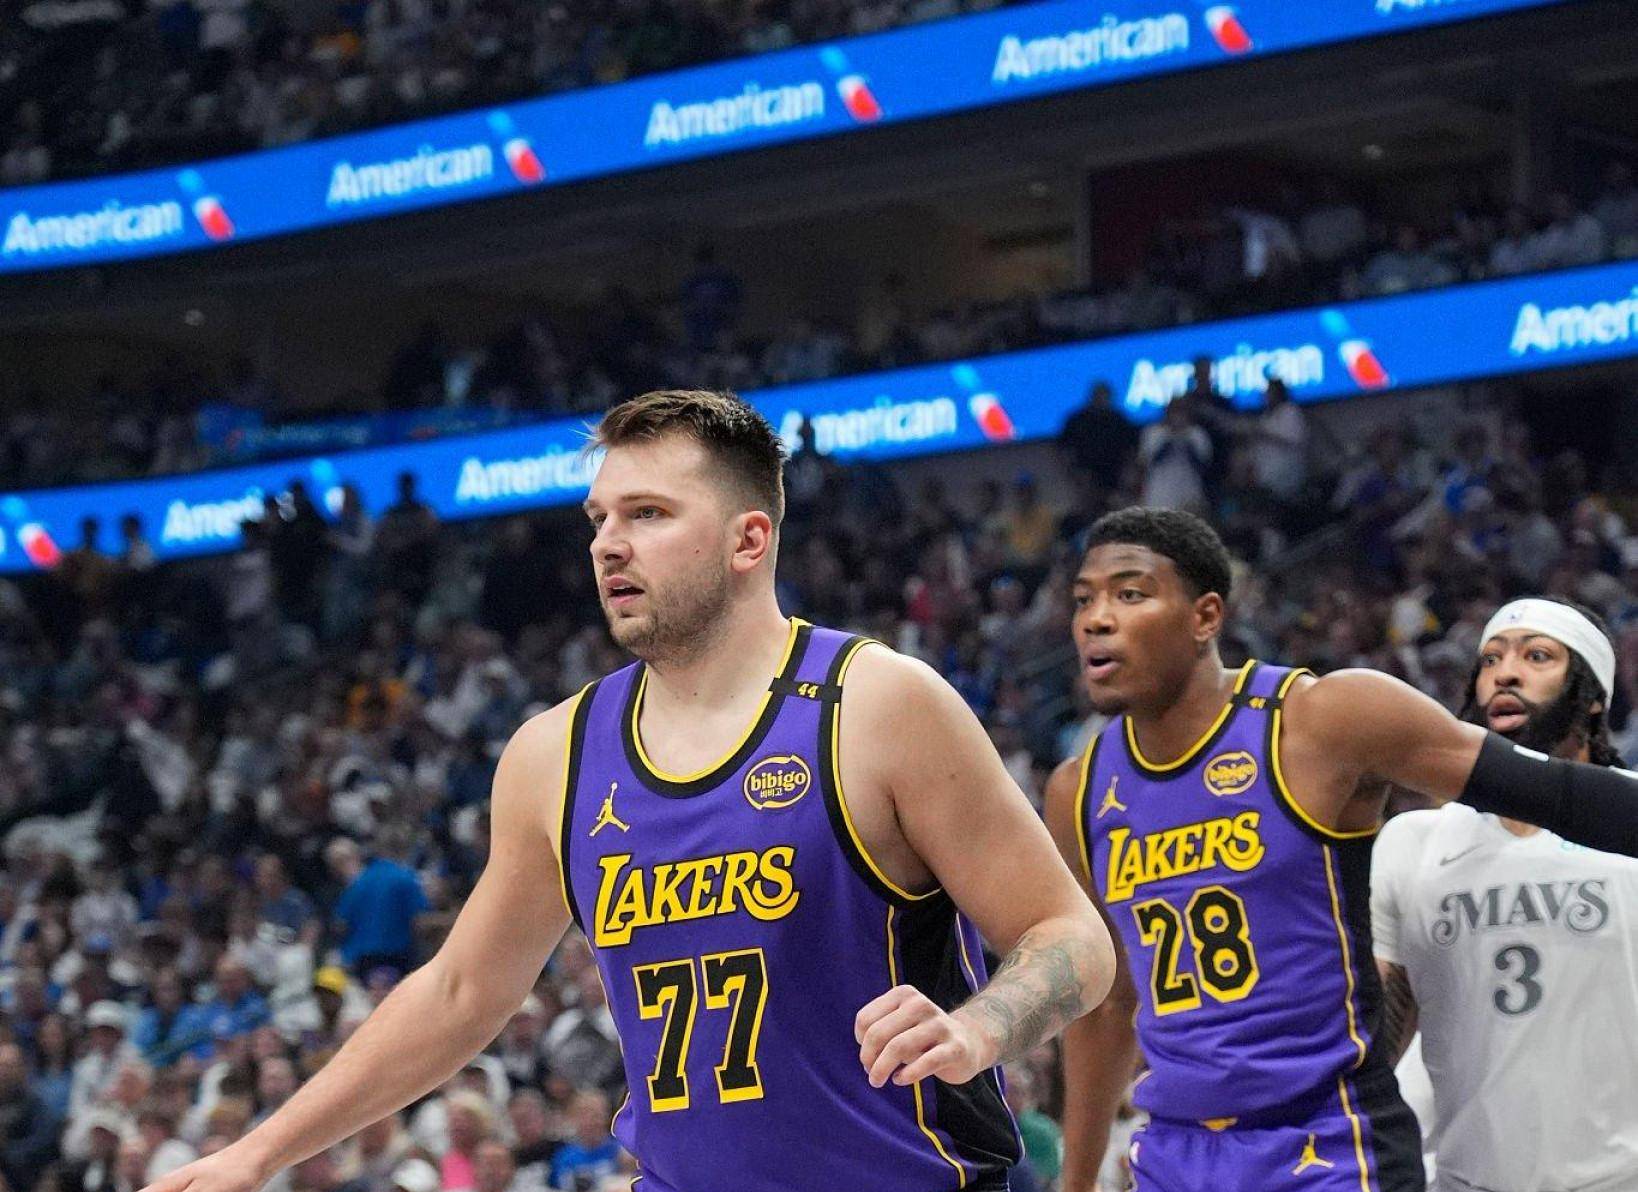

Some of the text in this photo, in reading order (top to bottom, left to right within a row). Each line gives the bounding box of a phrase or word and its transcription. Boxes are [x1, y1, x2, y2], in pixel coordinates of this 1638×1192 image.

[992, 13, 1188, 84] American
[645, 81, 824, 146] American
[326, 144, 493, 209] American
[4, 198, 182, 256] American
[798, 683, 819, 699] 44
[750, 770, 807, 792] bibigo
[1431, 878, 1611, 946] MAVS
[1130, 885, 1260, 1017] 28
[1494, 944, 1543, 1016] 3
[631, 947, 769, 1113] 77
